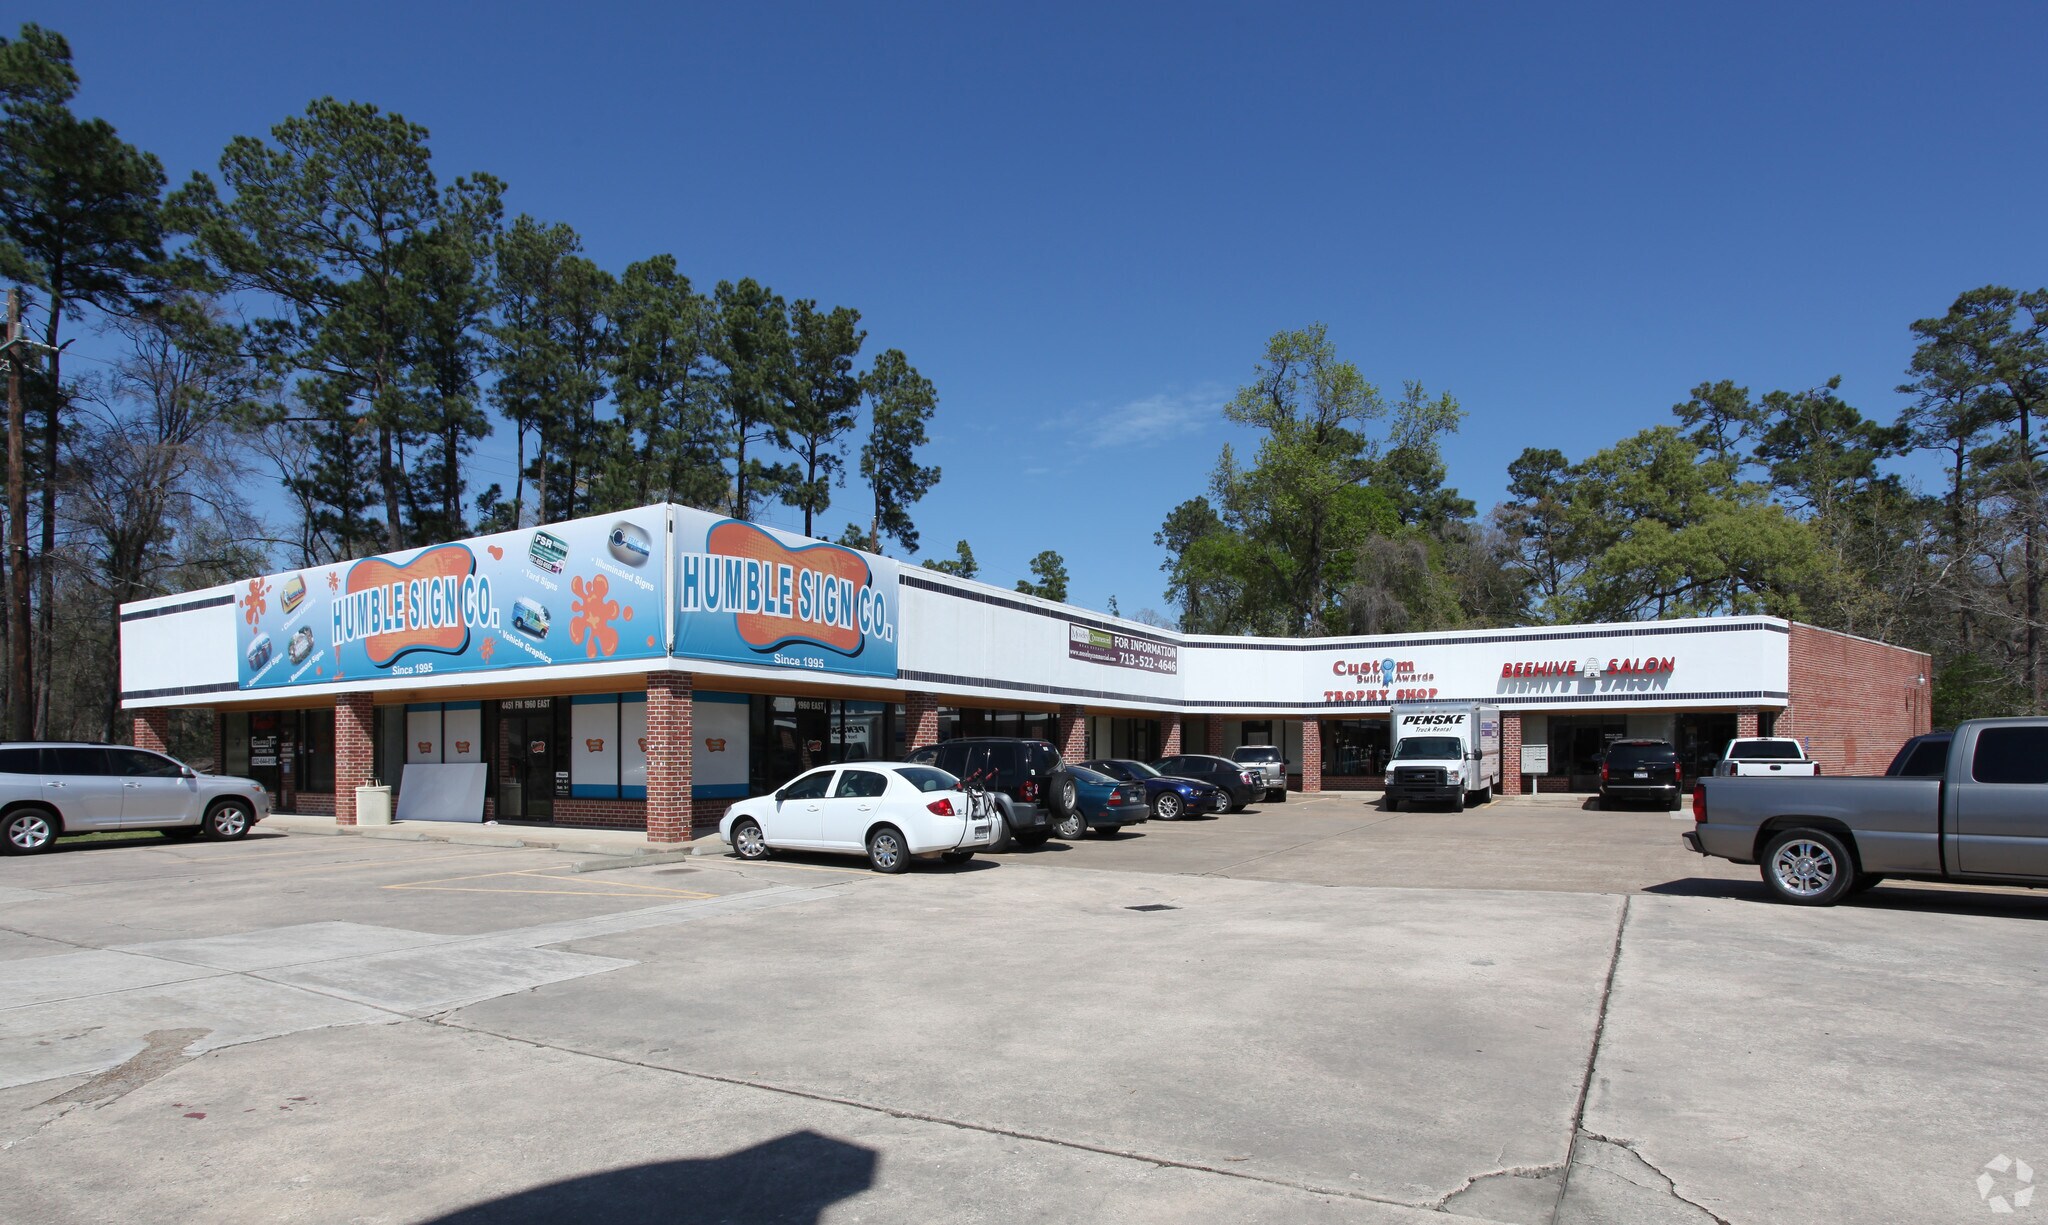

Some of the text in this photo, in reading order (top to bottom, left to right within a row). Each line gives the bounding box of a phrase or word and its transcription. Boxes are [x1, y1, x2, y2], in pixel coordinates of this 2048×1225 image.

[535, 534, 553, 548] FSR
[526, 569, 558, 592] Yard Signs
[595, 558, 655, 591] Illuminated Signs
[680, 552, 893, 643] HUMBLE SIGN CO.
[331, 573, 500, 647] HUMBLE SIGN CO.
[502, 630, 552, 664] Vehicle Graphics
[1114, 636, 1177, 658] FOR INFORMATION
[392, 662, 433, 676] Since 1995
[773, 653, 824, 669] Since 1995
[1119, 652, 1177, 672] 713-522-4646
[1333, 659, 1415, 676] Custom
[1502, 656, 1676, 678] BEEHIVE SALON
[1356, 672, 1435, 684] Built Awards
[1323, 688, 1438, 702] TROPHY SHOP
[515, 700, 523, 709] FM
[524, 700, 537, 709] 1960
[537, 699, 550, 708] EAST
[798, 701, 811, 709] 1960
[811, 701, 825, 710] EAST
[1402, 714, 1466, 725] PENSKE
